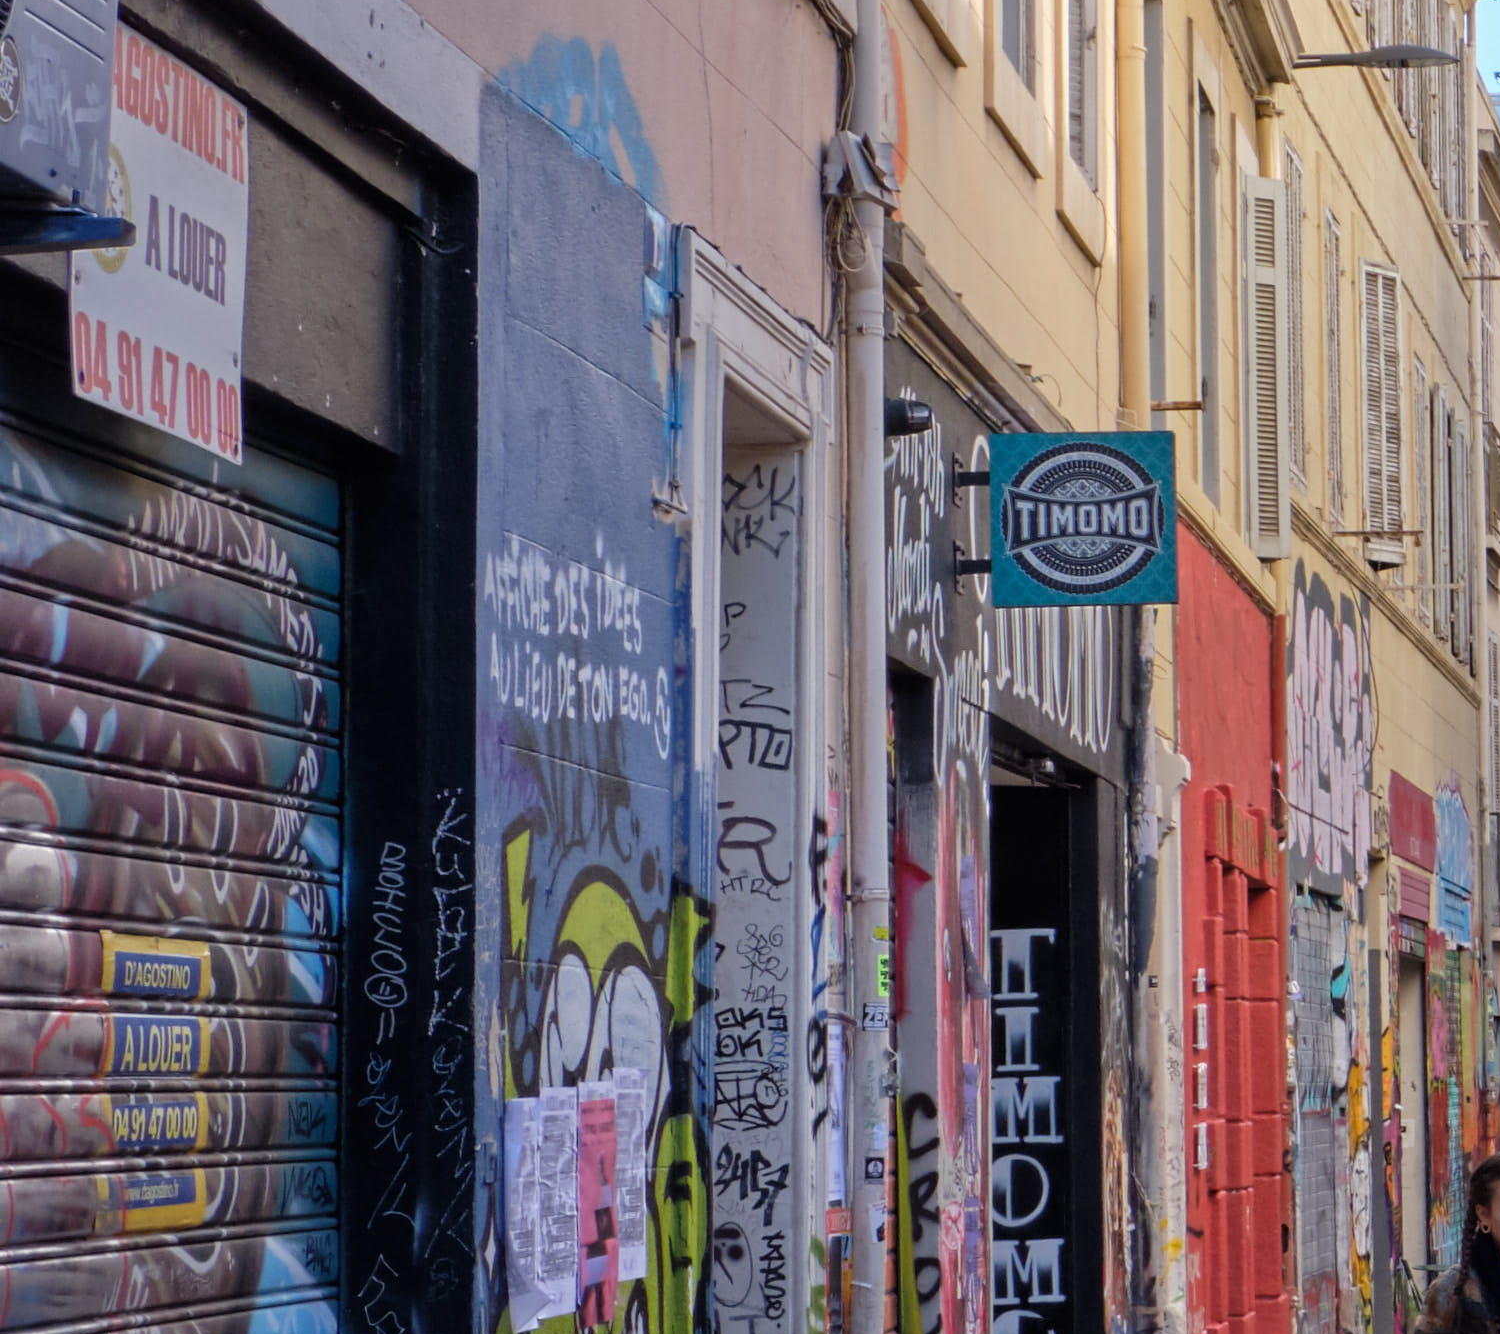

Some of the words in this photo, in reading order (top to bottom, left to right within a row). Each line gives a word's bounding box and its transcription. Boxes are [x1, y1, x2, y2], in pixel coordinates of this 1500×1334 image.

[145, 194, 161, 271] A
[167, 204, 227, 308] LOUER
[74, 311, 112, 402] 04
[117, 329, 144, 417] 91
[150, 345, 180, 430] 47
[185, 361, 212, 441] 00
[215, 377, 240, 460] 00
[1014, 496, 1151, 542] TIMOMO
[555, 563, 590, 640] DES
[490, 632, 511, 705] AU
[557, 652, 577, 719] DE
[578, 664, 614, 723] TON
[124, 959, 192, 991] D'AGOSTINO
[121, 1025, 136, 1072] A
[138, 1023, 193, 1074] LOUER
[113, 1107, 129, 1143] 04
[130, 1107, 147, 1142] 91
[148, 1107, 164, 1141] 47
[165, 1106, 181, 1141] 00
[182, 1105, 198, 1139] 00
